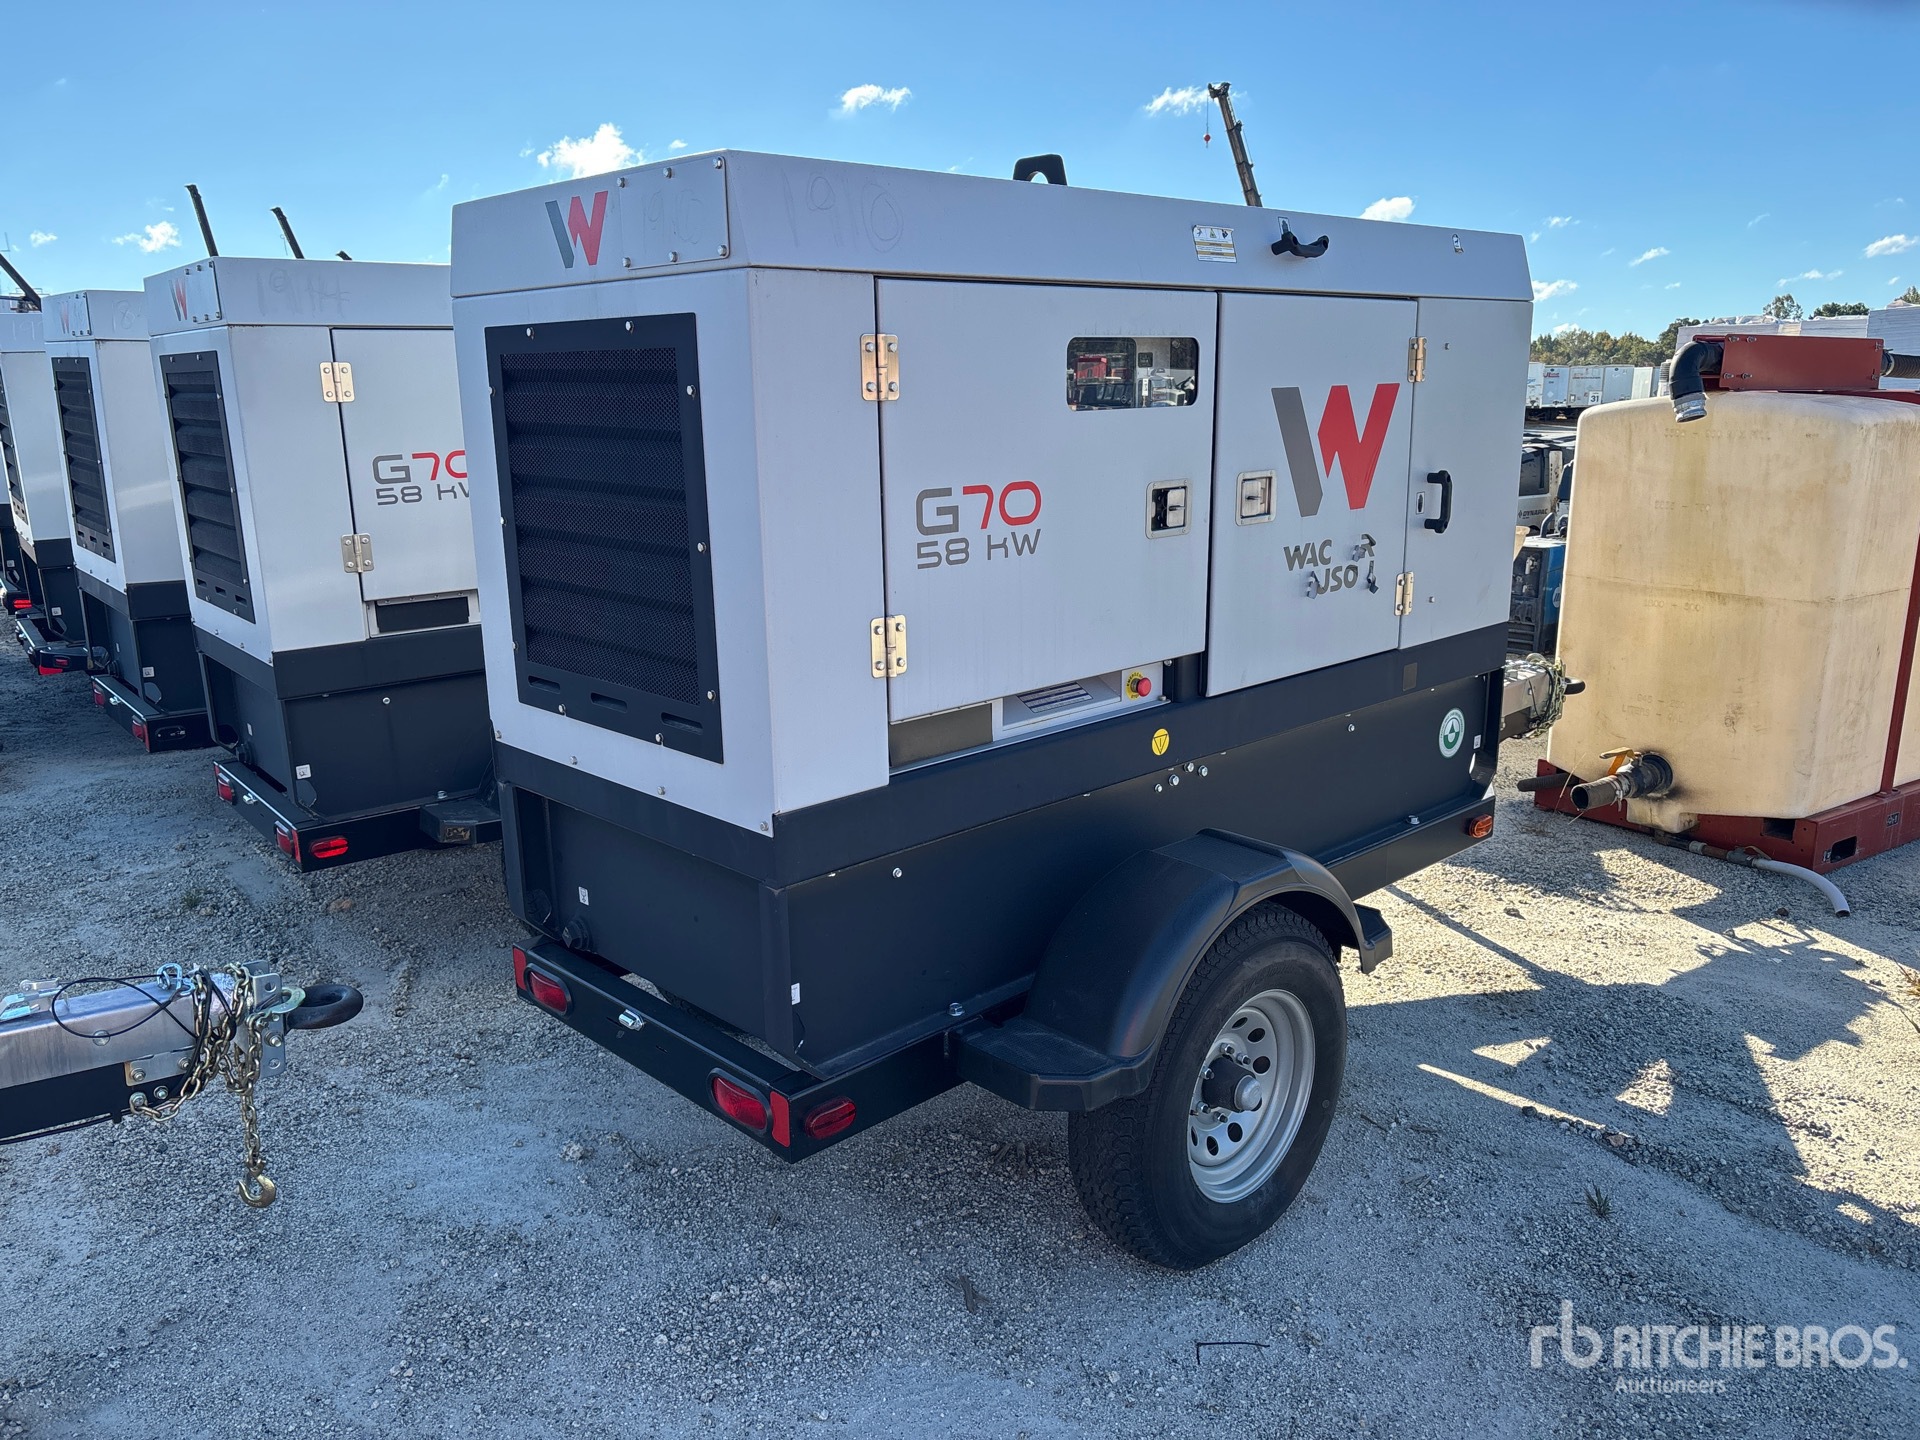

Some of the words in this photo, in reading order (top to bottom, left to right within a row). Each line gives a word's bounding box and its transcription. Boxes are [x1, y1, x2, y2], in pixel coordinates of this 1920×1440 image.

[1590, 395, 1599, 403] 31
[372, 450, 468, 484] G70
[376, 485, 422, 505] 58
[916, 481, 1042, 536] G70
[1523, 509, 1548, 517] DYNAPAC
[917, 537, 970, 569] 58
[987, 528, 1041, 561] kW
